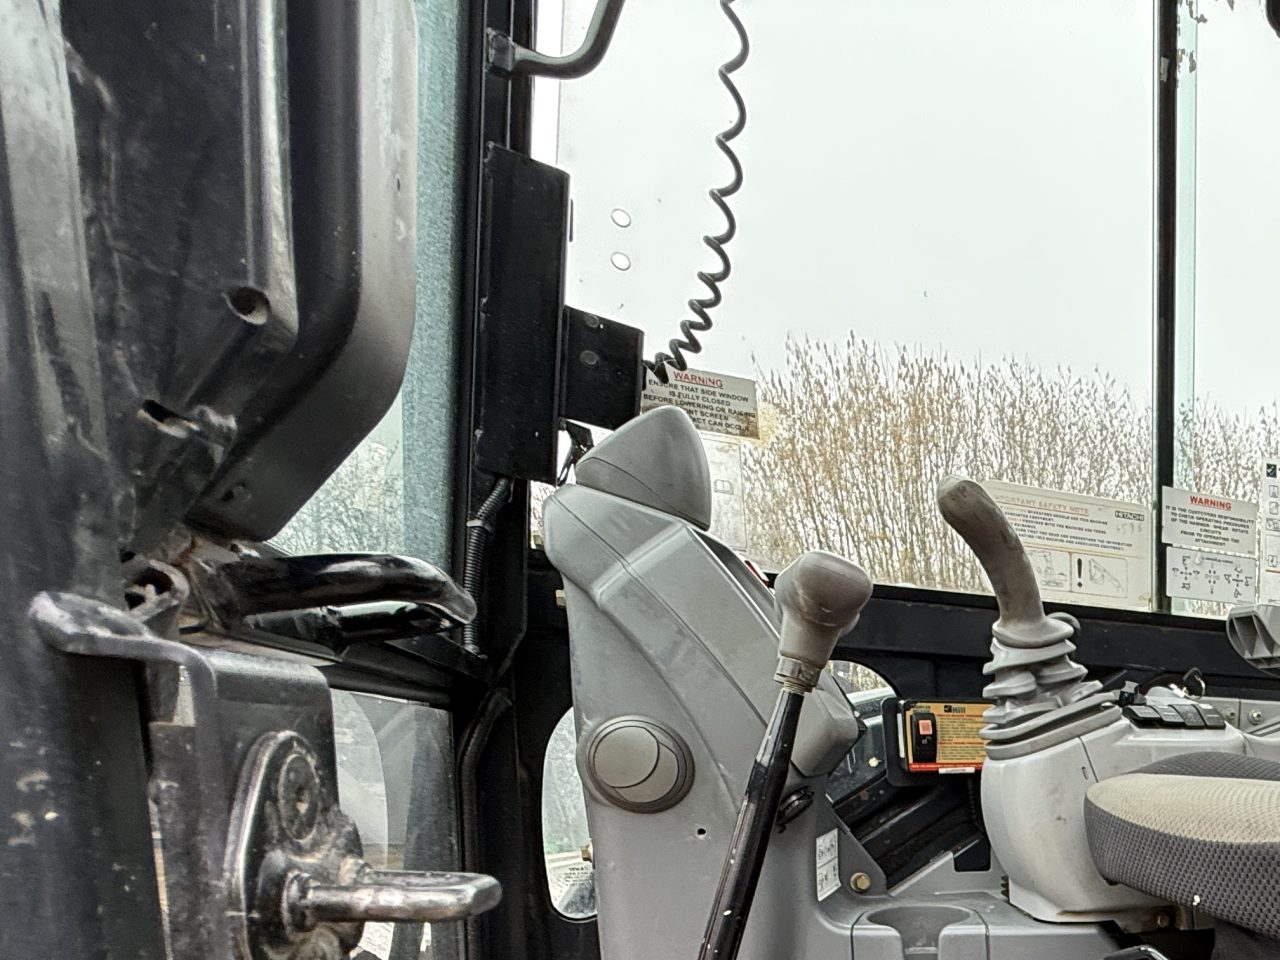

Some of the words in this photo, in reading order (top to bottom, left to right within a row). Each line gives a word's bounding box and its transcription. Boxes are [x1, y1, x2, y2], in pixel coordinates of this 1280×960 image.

[674, 371, 723, 388] WARNING
[678, 392, 699, 401] FULLY
[702, 396, 731, 406] CLOSED
[680, 385, 698, 393] THAT
[701, 389, 717, 398] SIDE
[719, 392, 748, 402] WINDOW
[644, 394, 673, 404] BEFORE
[675, 399, 714, 412] LOWERING
[700, 411, 728, 421] SCREEN
[1190, 496, 1232, 510] WARNING
[1115, 511, 1144, 521] HITACHI
